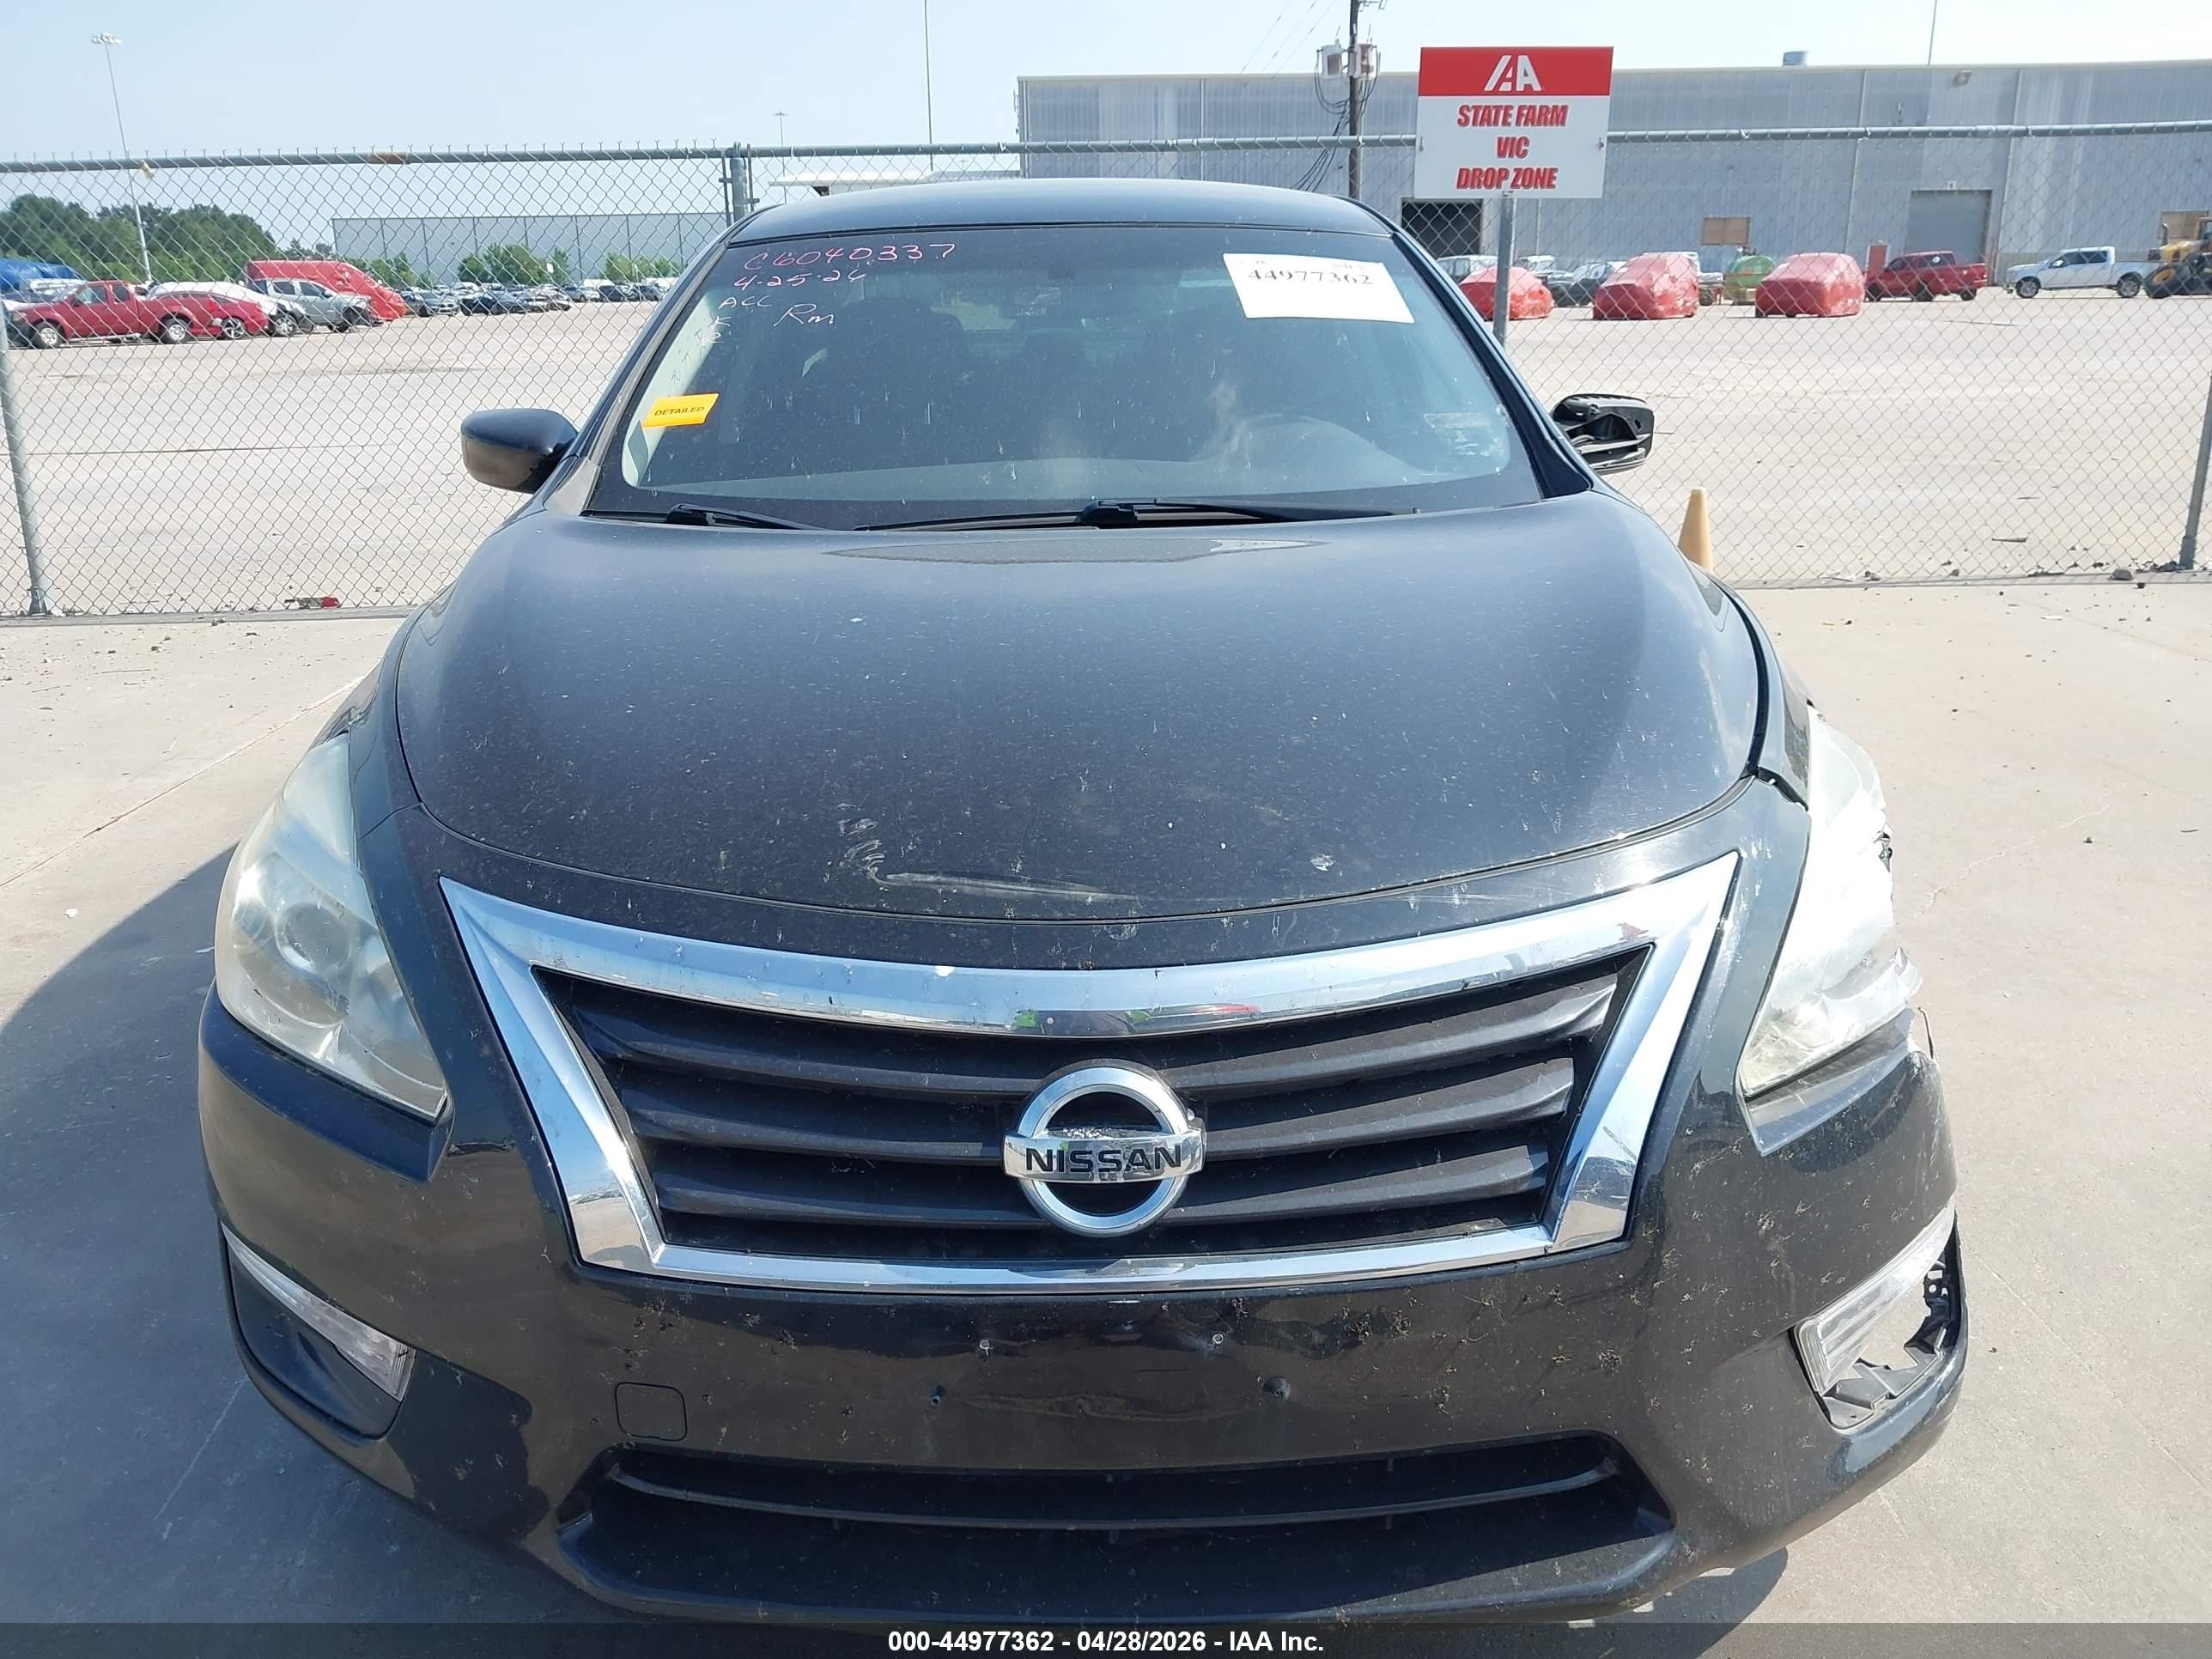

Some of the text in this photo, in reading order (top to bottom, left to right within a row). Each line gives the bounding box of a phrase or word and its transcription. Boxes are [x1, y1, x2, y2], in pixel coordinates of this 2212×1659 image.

[1457, 105, 1569, 127] STATE FARM
[1497, 137, 1530, 159] VIC
[1456, 167, 1559, 190] DROP ZONE
[744, 243, 956, 270] C6040337
[653, 405, 705, 416] DETAILED
[1025, 1145, 1182, 1173] NISSAN
